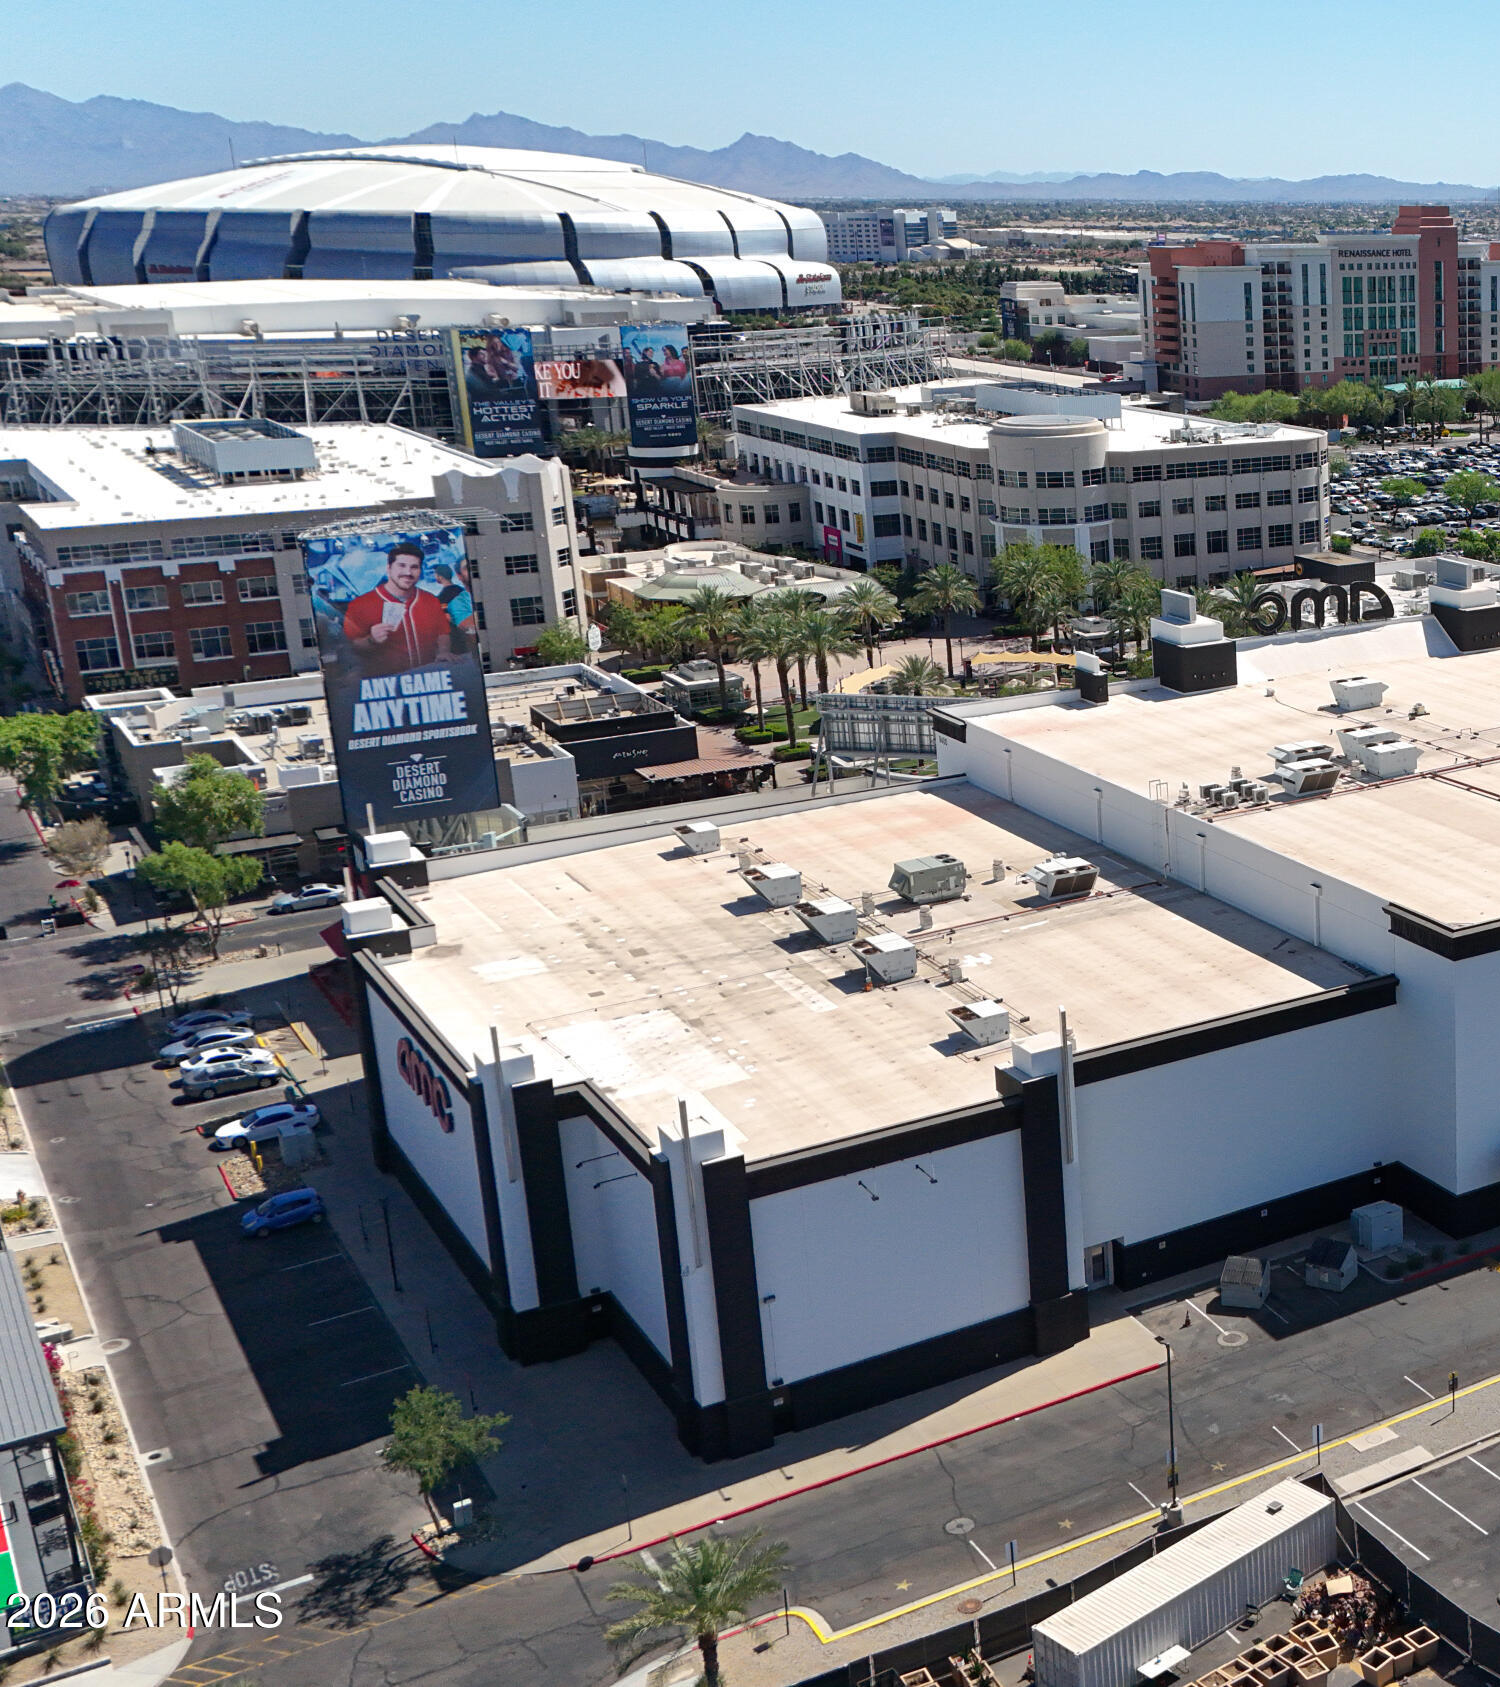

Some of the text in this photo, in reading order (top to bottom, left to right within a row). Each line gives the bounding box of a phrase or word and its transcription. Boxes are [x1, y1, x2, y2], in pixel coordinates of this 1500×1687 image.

[1338, 248, 1412, 258] RENAISSANCE HOTEL
[376, 327, 441, 342] DESER
[369, 343, 444, 357] DIAMO
[534, 362, 581, 380] KE YOU
[539, 381, 553, 398] IT
[473, 404, 536, 415] HOTTEST
[636, 401, 689, 411] SPARKLE
[481, 413, 532, 423] ACTION
[361, 670, 453, 701] ANY GAME
[354, 691, 468, 732] ANYTIME
[348, 723, 478, 750] DESERT DIAMOND SPORTSBOOK
[396, 761, 441, 779] DESERT
[392, 773, 448, 792] DIAMOND
[399, 785, 444, 803] CASINO
[223, 1561, 273, 1593] STOP
